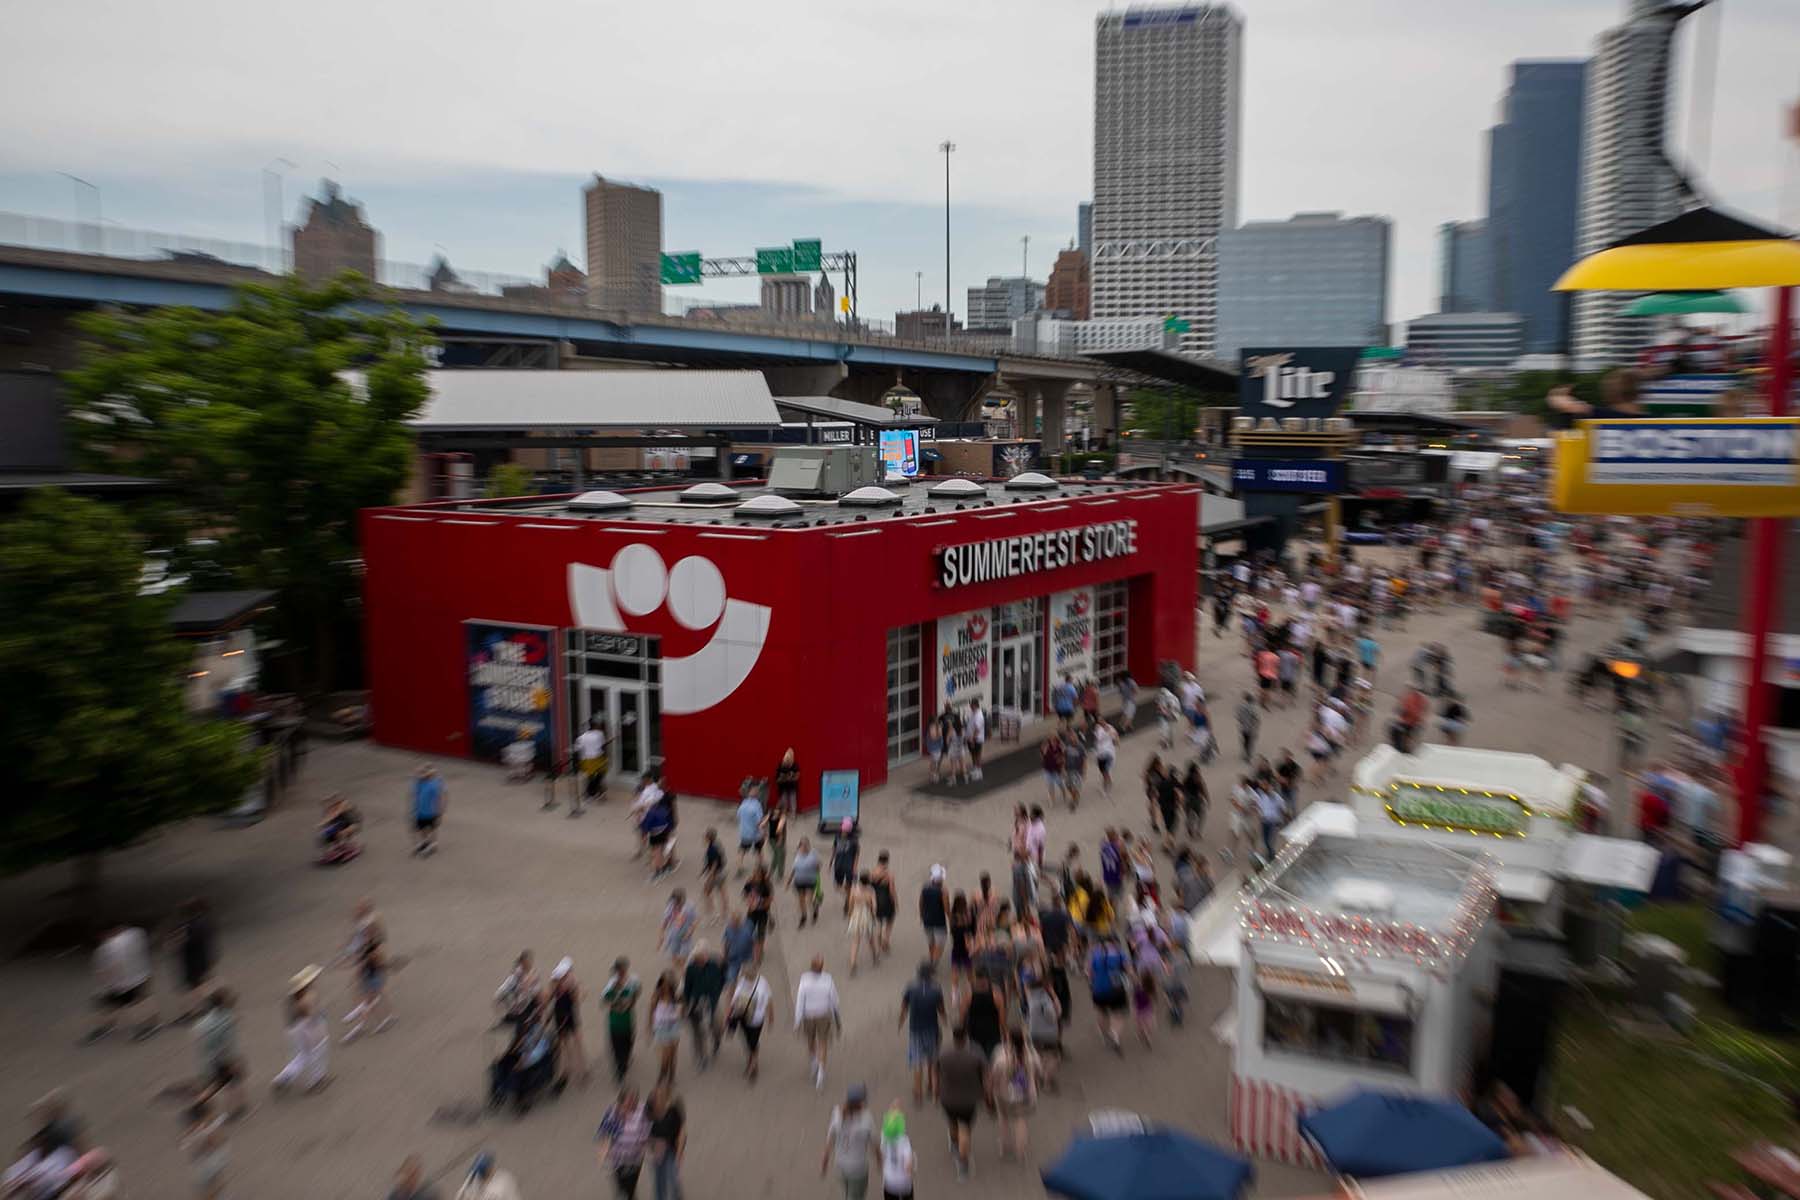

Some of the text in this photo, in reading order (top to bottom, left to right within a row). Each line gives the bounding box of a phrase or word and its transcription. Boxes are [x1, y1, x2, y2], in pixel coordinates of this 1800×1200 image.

[1259, 365, 1336, 408] Lite
[823, 430, 850, 441] MILLER
[943, 520, 1138, 588] SUMMERFEST STORE
